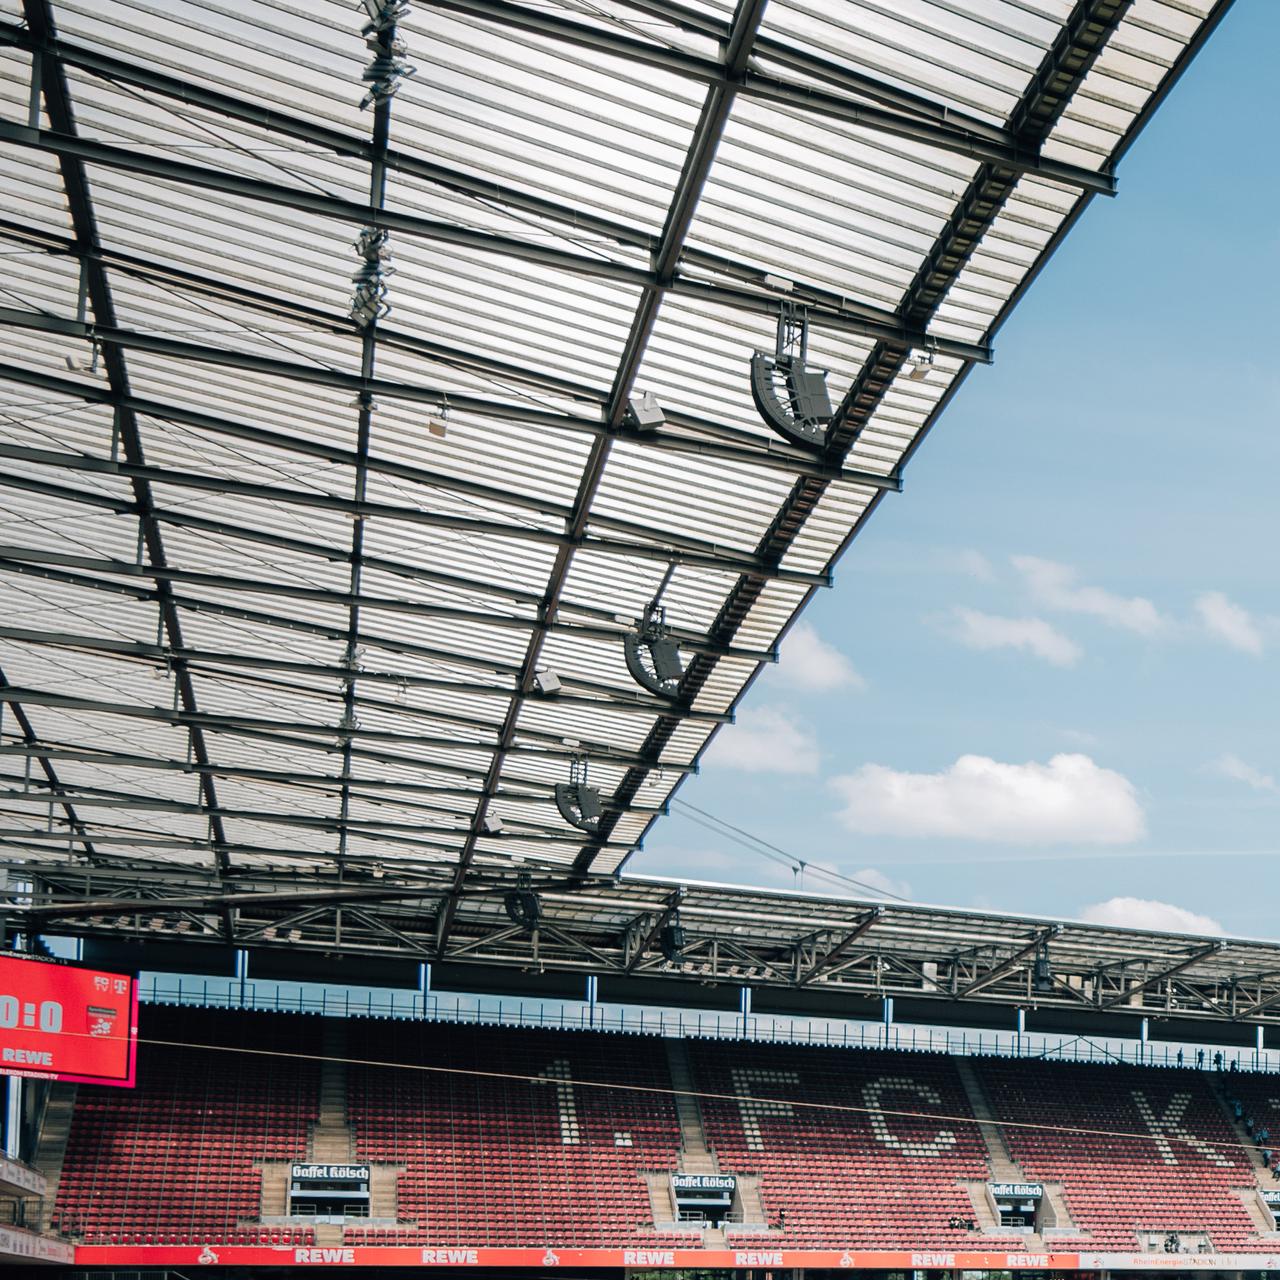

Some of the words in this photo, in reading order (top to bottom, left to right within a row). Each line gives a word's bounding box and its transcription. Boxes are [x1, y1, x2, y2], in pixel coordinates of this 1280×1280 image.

[114, 979, 127, 994] T
[0, 994, 63, 1034] 0:0
[2, 1048, 53, 1066] REWE
[293, 1166, 328, 1180] Gaffel
[330, 1166, 368, 1180] Kölsch
[672, 1176, 701, 1188] Gaffel
[702, 1176, 735, 1189] Kölsch
[1014, 1185, 1042, 1197] Kölsch
[295, 1250, 355, 1263] REWE
[422, 1250, 478, 1263] REWE
[624, 1252, 674, 1265] REWE
[736, 1252, 783, 1265] REWE
[912, 1254, 955, 1266] REWE
[1007, 1255, 1048, 1266] REWE
